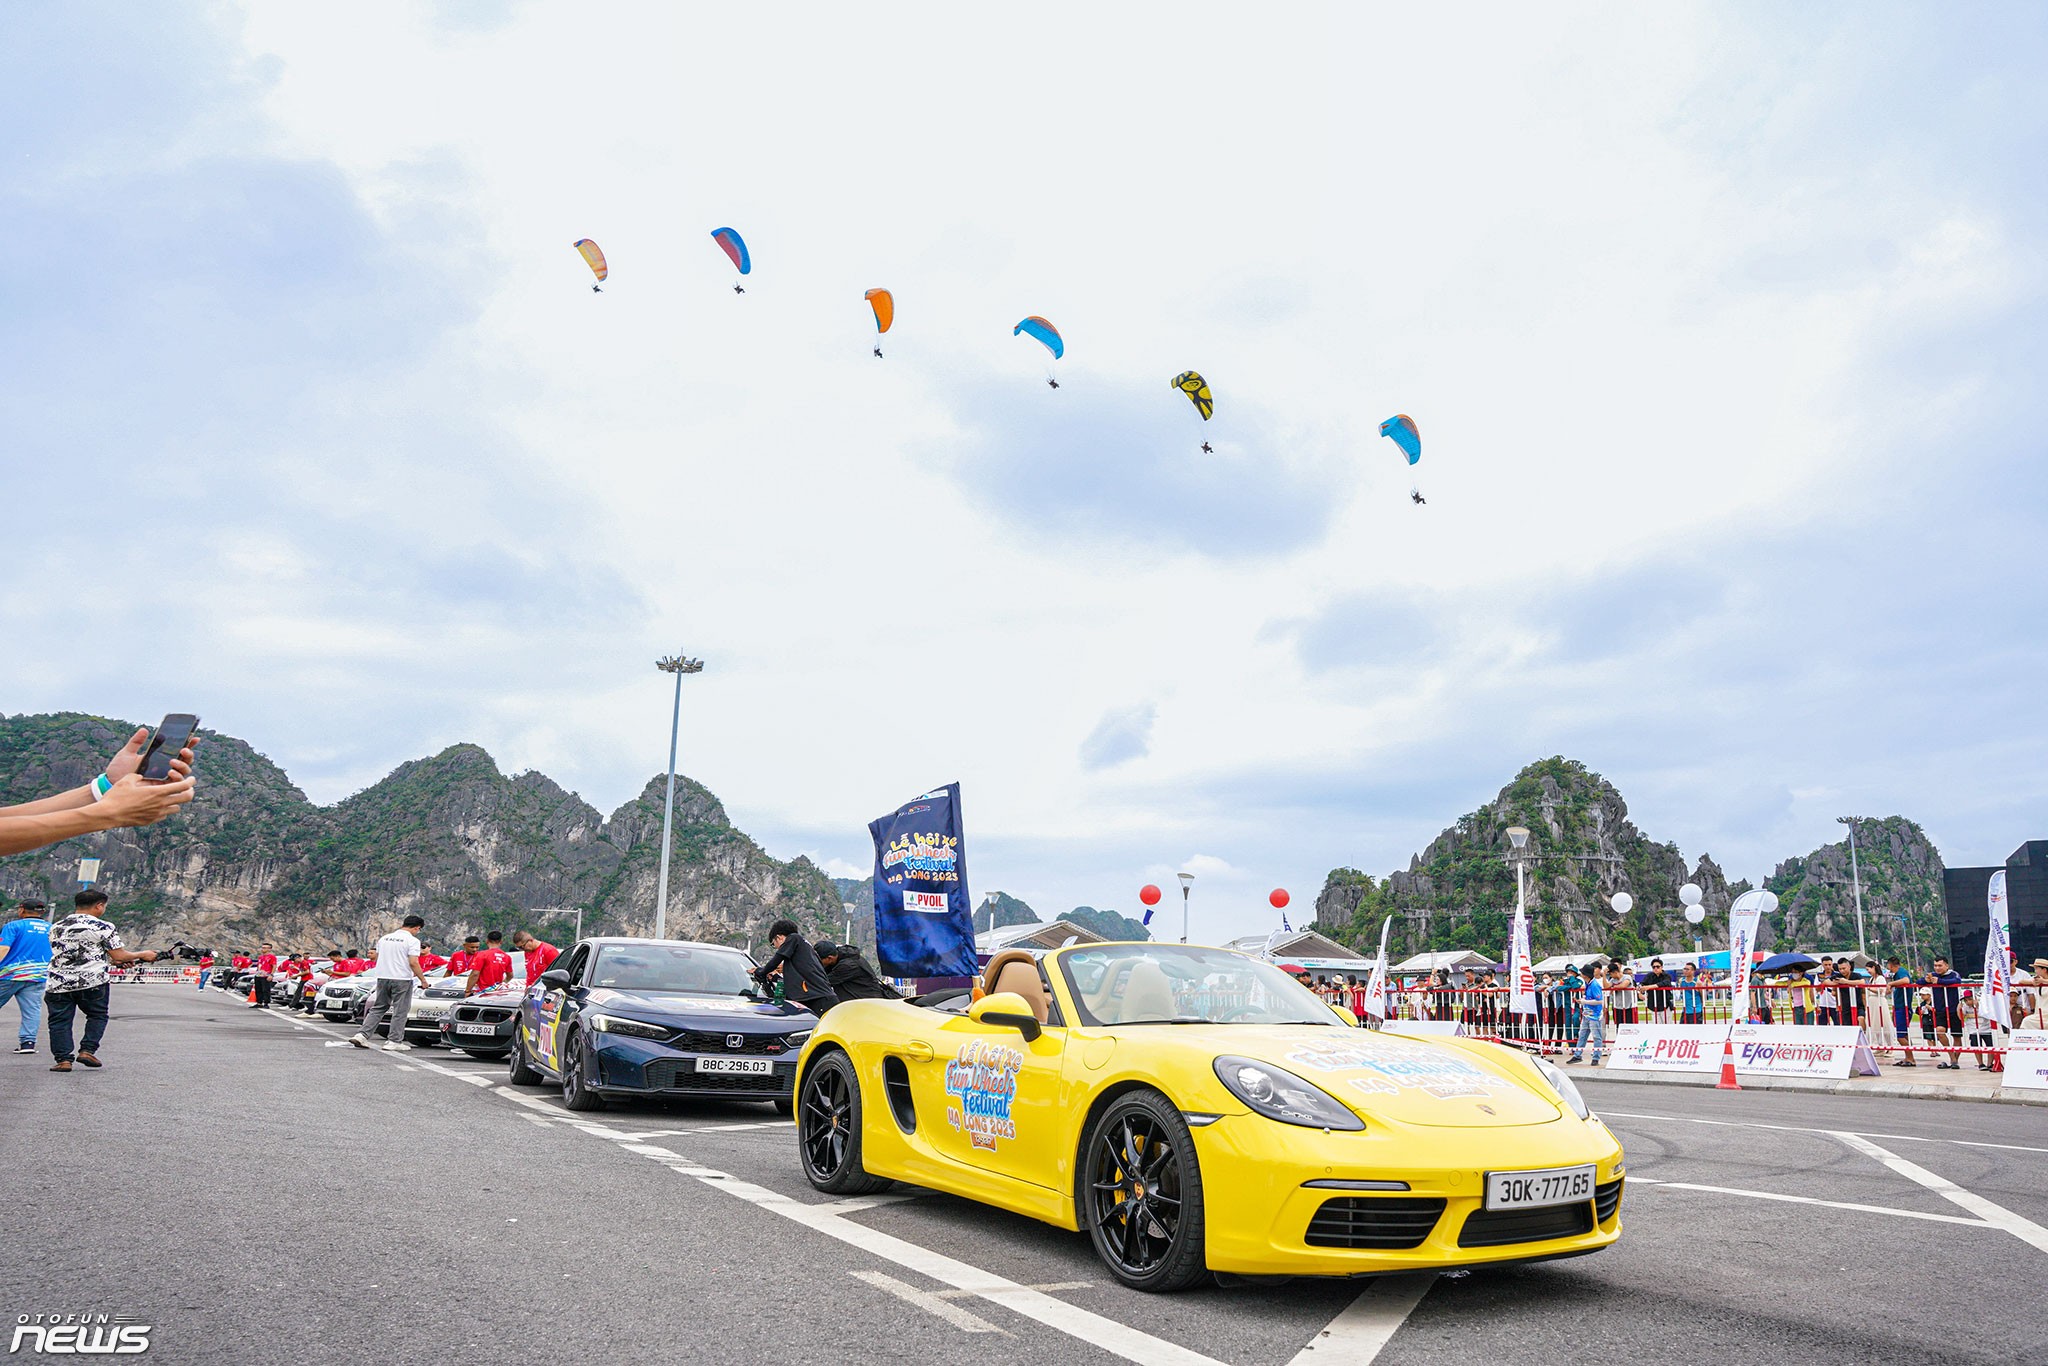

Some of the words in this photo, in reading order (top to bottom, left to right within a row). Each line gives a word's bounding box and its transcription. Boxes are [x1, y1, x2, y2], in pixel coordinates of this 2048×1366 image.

[910, 844, 957, 860] Wheels
[904, 856, 956, 871] Festival
[904, 870, 931, 881] LONG
[917, 893, 945, 907] PVOIL
[1654, 1039, 1700, 1059] PVOIL
[1741, 1043, 1833, 1067] Ekokemika
[702, 1059, 767, 1072] 88C-296.03
[946, 1062, 970, 1091] Fun
[971, 1065, 1015, 1098] Wheels
[962, 1086, 1010, 1119] Festival
[963, 1114, 988, 1133] LONG
[1499, 1172, 1590, 1203] 30K-777.65
